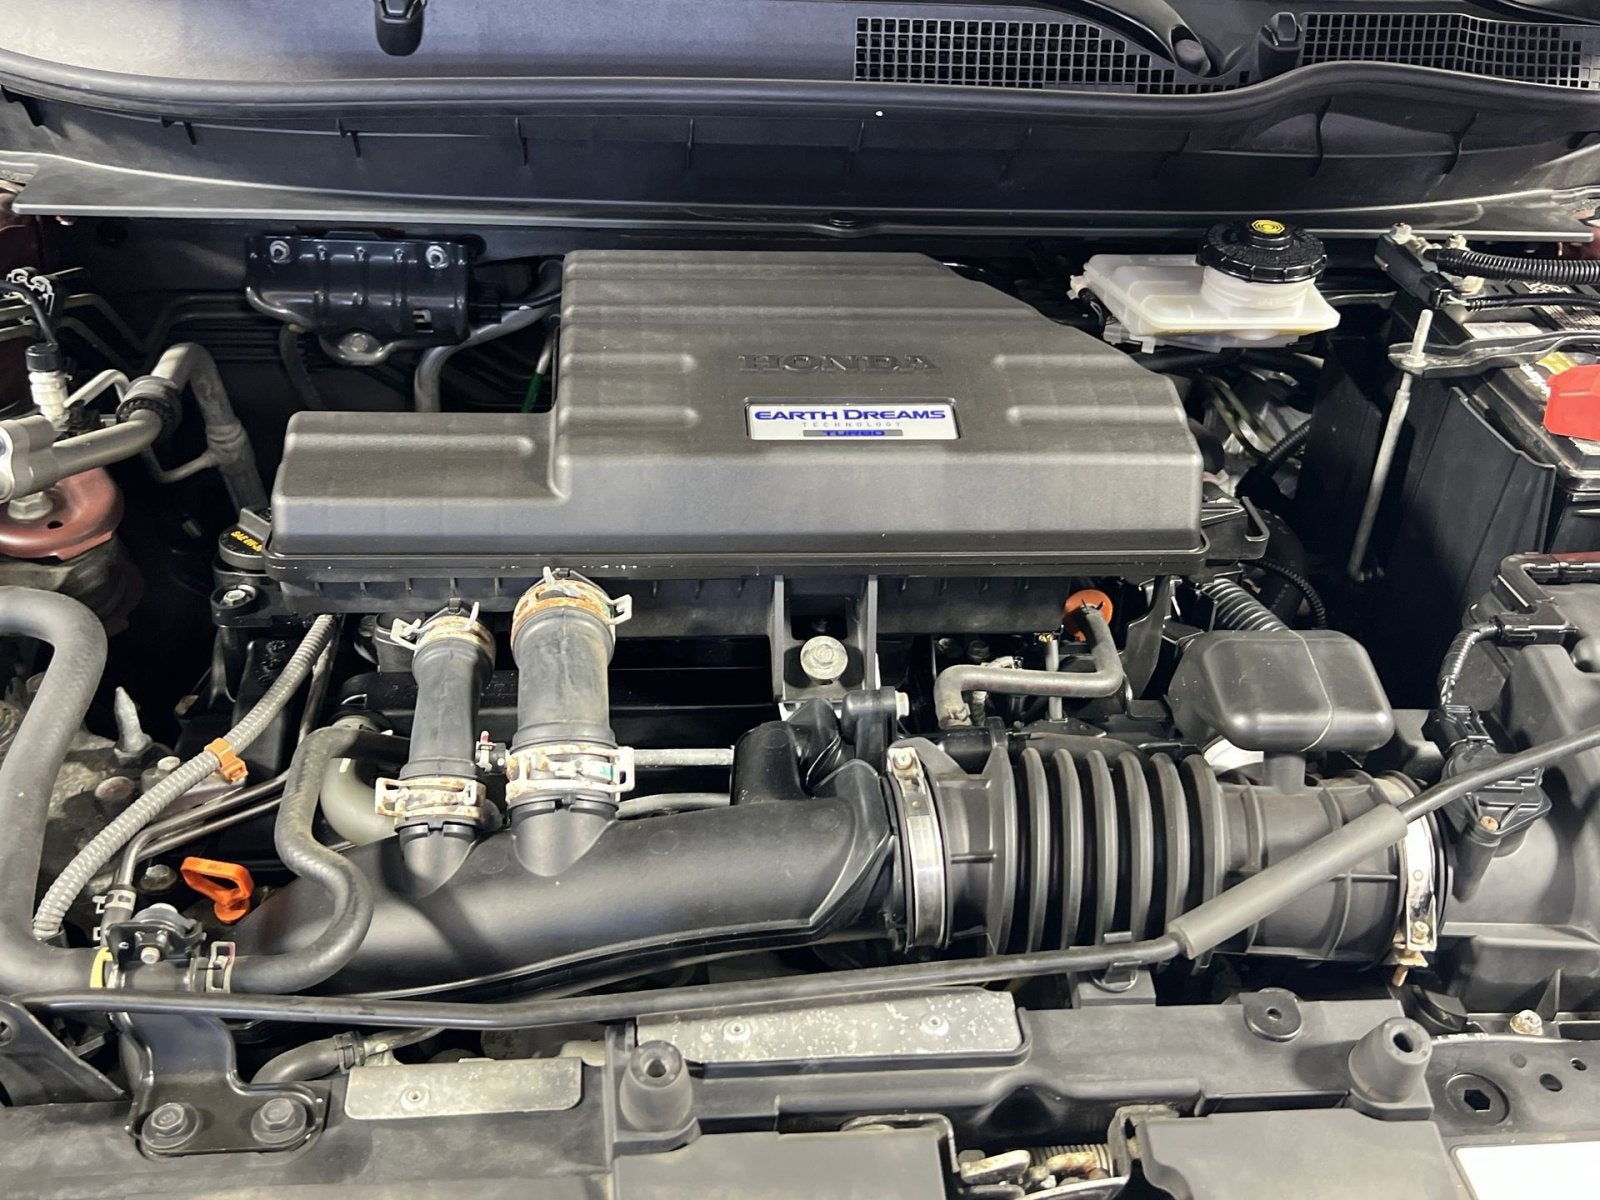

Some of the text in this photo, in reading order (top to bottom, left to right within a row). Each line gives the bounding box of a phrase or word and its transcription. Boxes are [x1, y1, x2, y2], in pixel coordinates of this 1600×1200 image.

[738, 355, 940, 372] HONDA
[754, 409, 946, 420] EARTH DREAMS
